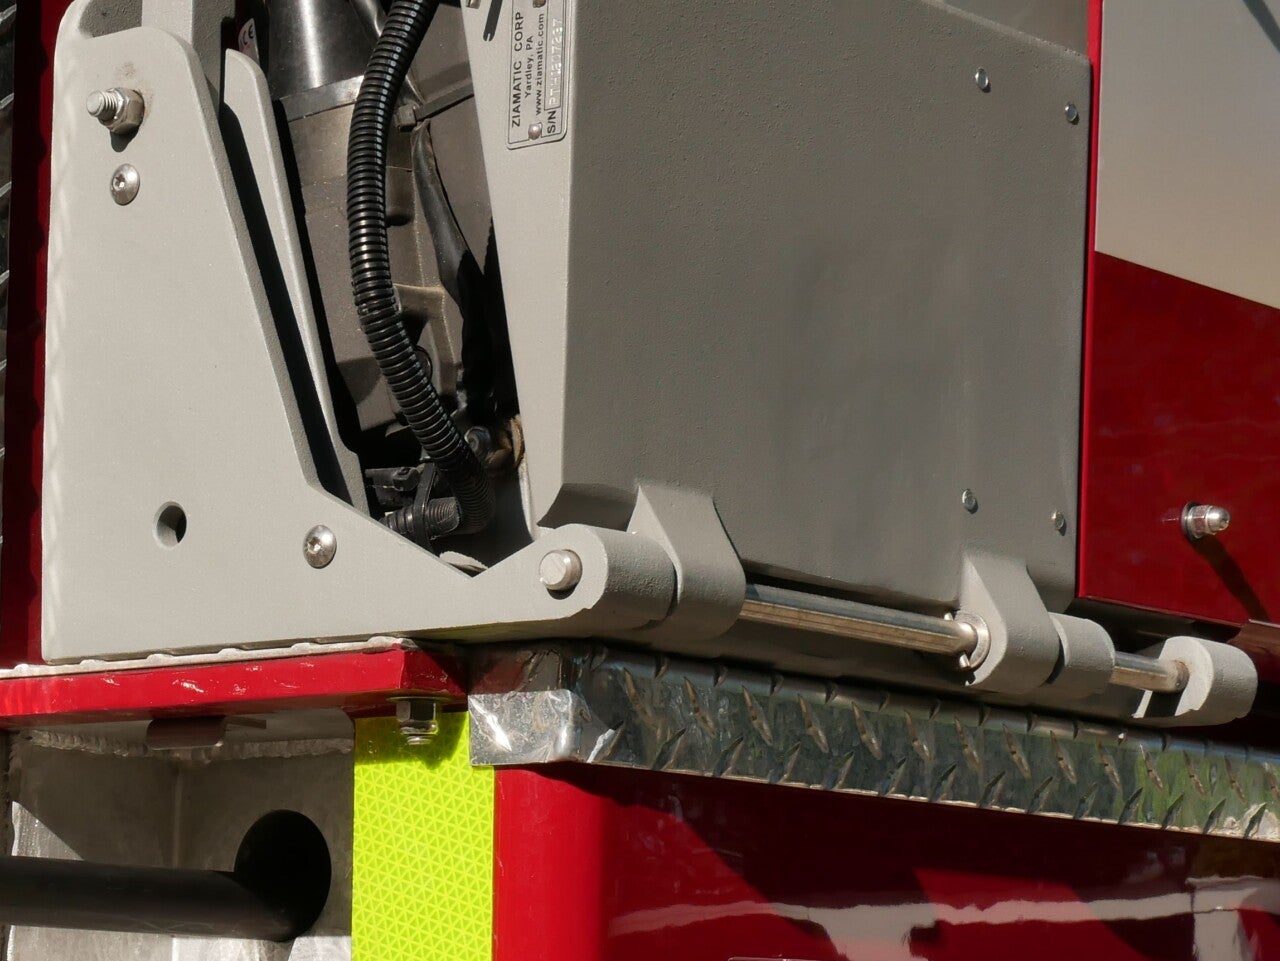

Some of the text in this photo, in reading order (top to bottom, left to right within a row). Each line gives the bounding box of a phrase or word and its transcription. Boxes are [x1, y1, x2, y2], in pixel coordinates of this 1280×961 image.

[511, 11, 524, 128] ZIAMATIC CORP
[526, 35, 534, 51] PA
[535, 13, 545, 116] www.ziamatic.com
[547, 110, 557, 134] S/N
